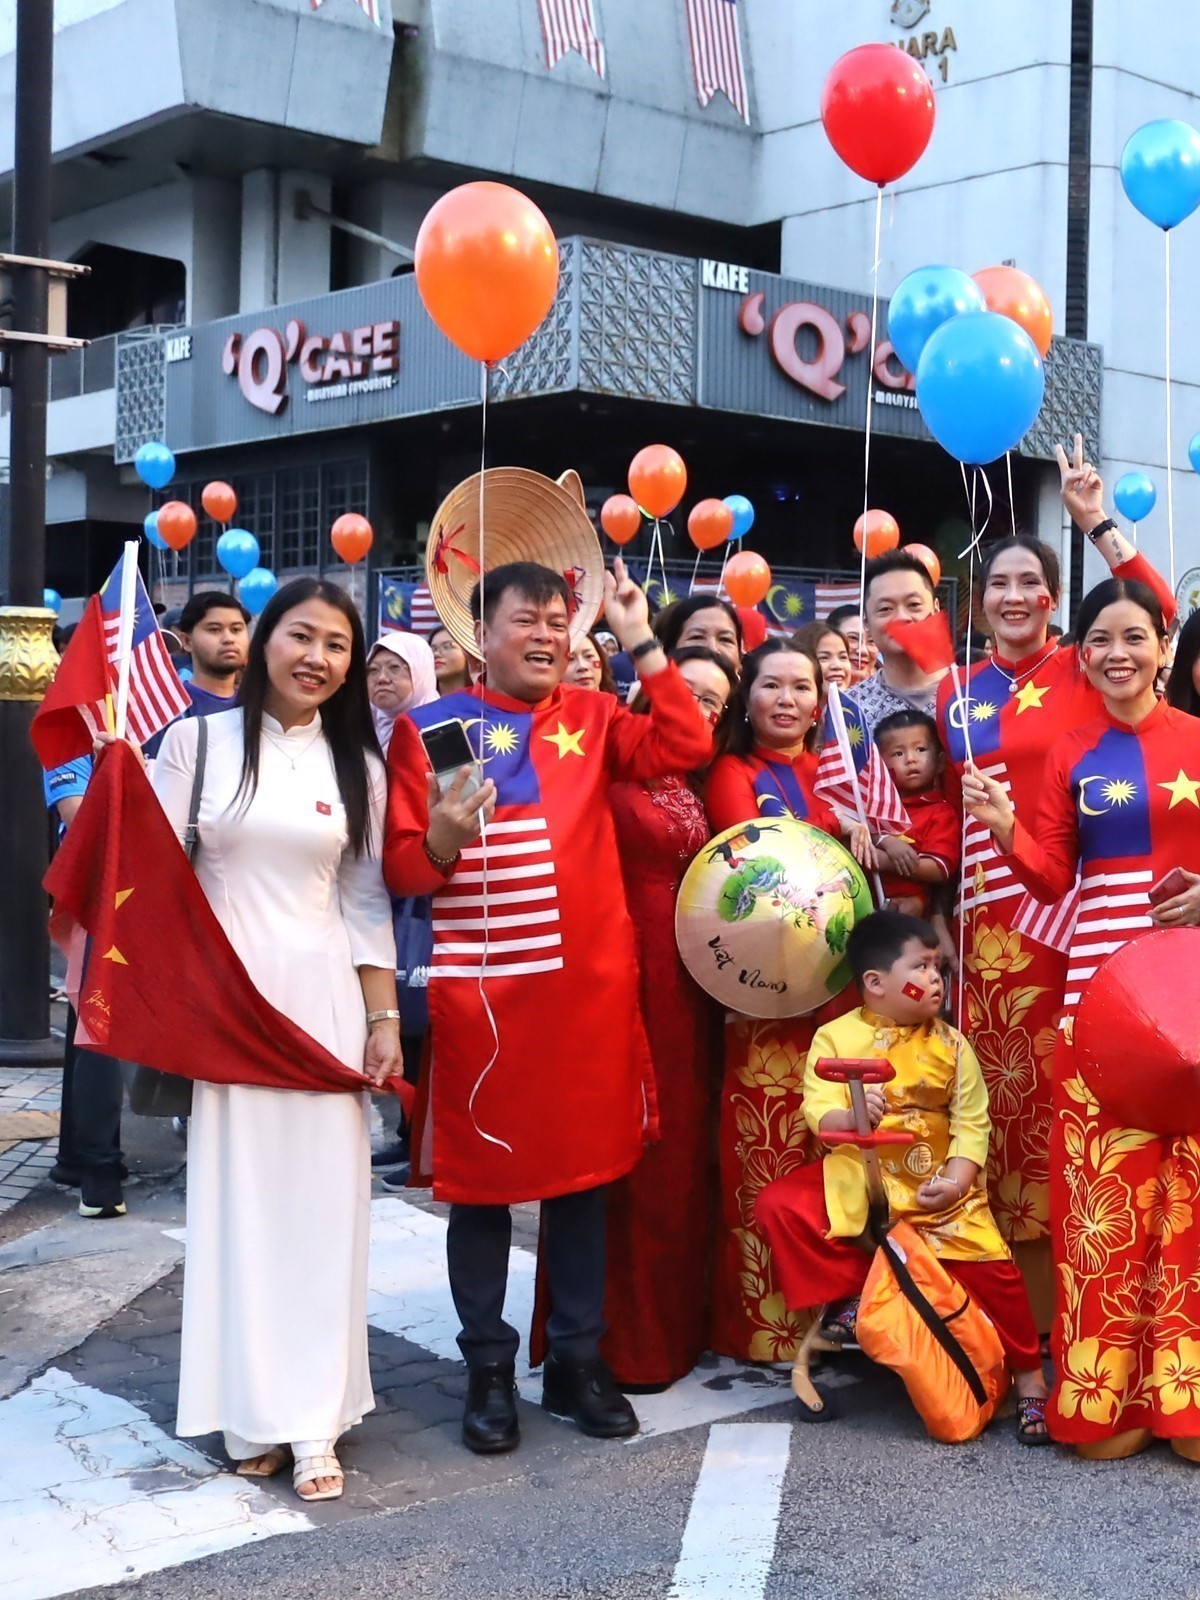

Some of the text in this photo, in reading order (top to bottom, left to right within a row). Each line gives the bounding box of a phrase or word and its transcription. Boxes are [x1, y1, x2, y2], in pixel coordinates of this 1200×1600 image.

[702, 259, 749, 293] KAFE
[166, 336, 193, 362] KAFE
[300, 321, 400, 384] CAFE
[739, 969, 788, 994] Nam
